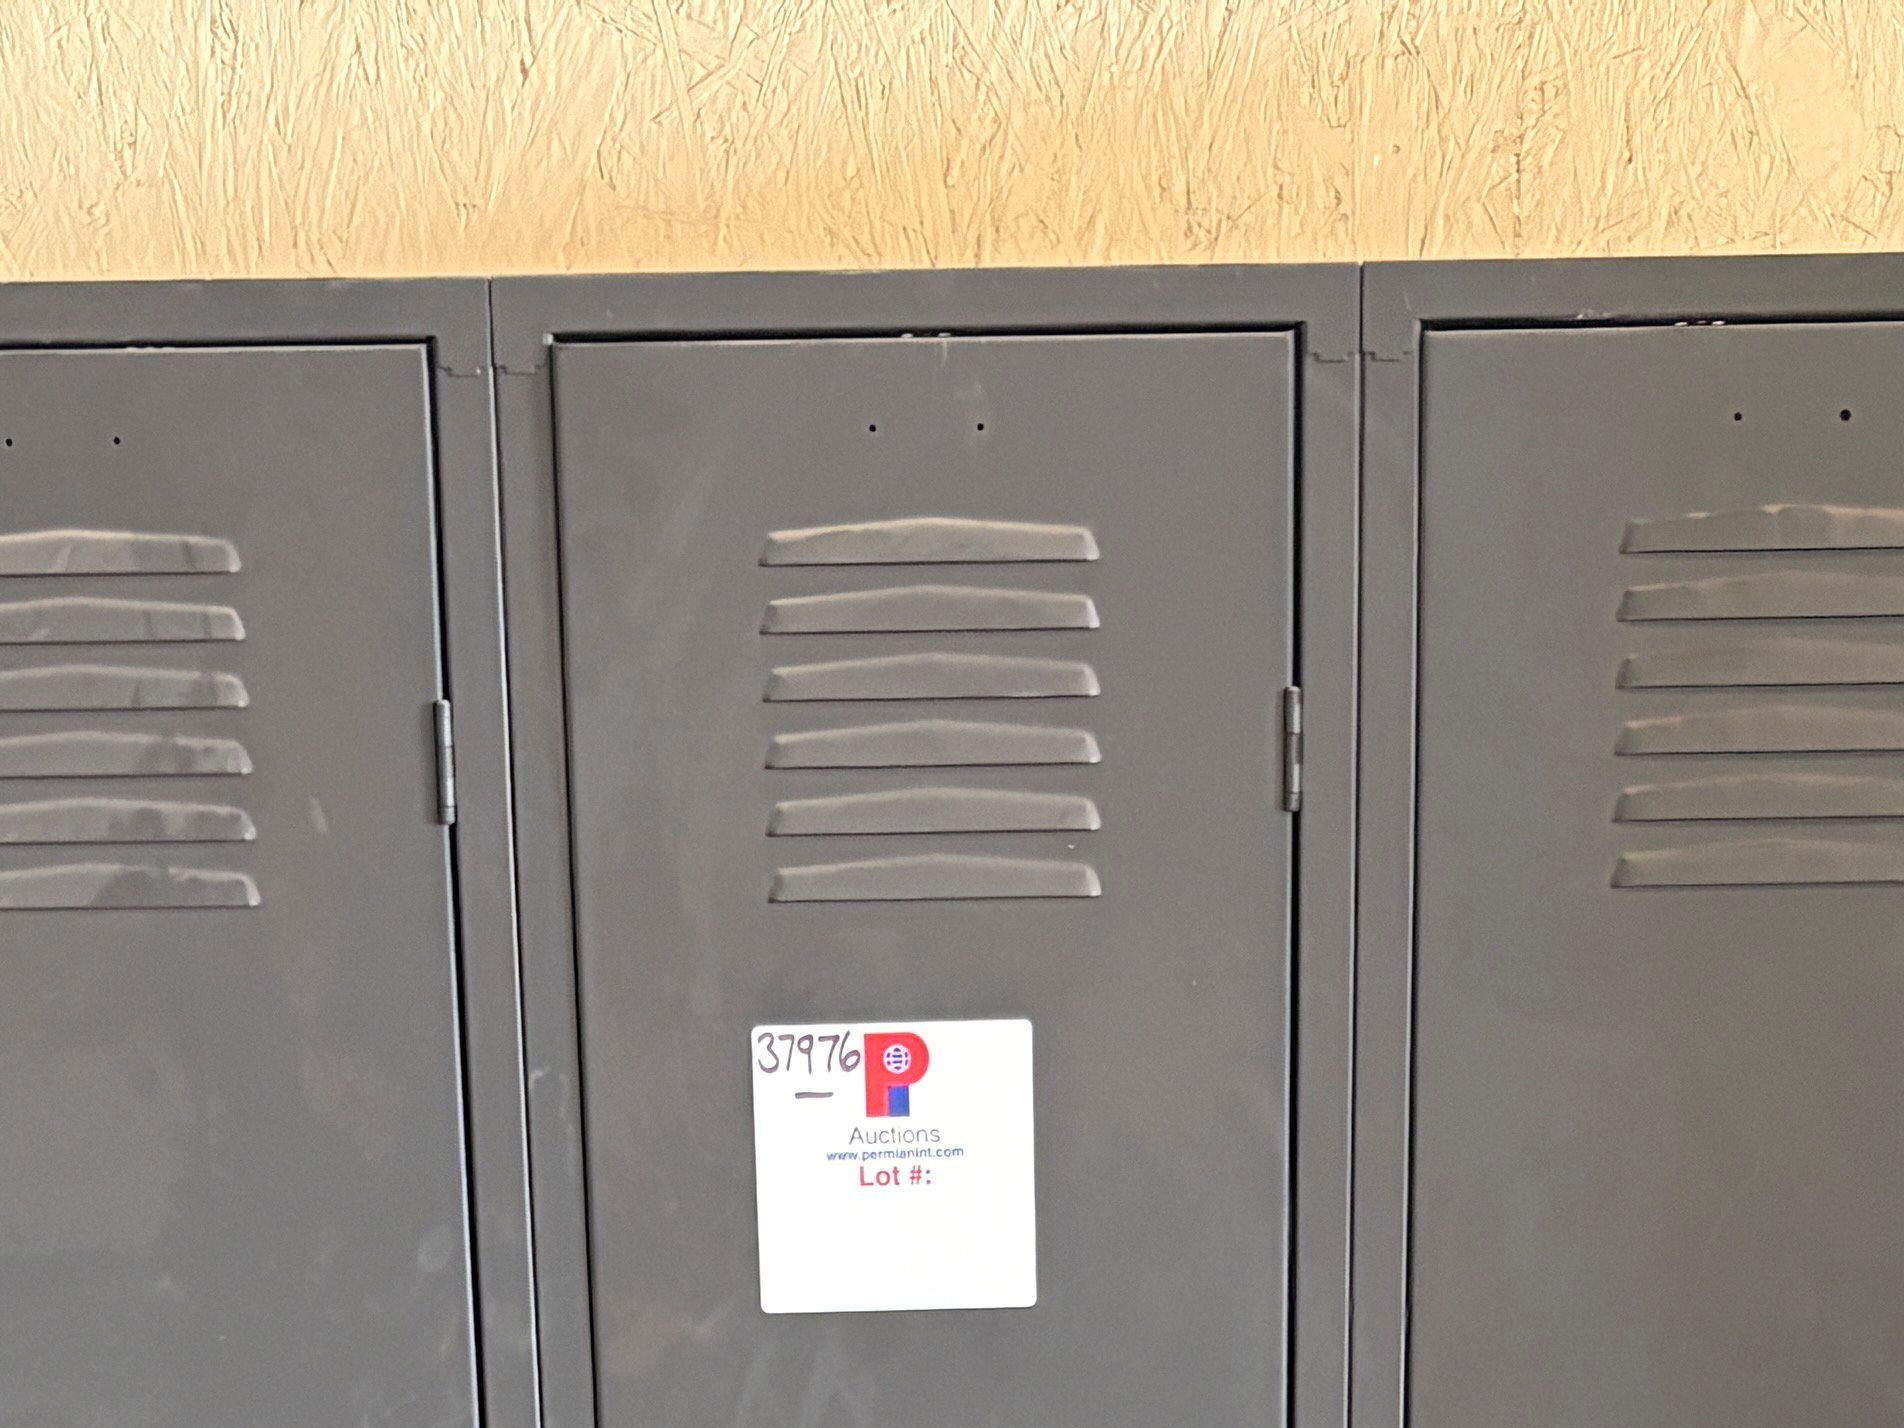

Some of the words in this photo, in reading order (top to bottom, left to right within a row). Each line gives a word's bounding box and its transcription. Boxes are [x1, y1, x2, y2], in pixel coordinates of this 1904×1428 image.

[757, 1029, 861, 1075] 37976
[848, 1126, 942, 1145] Auctions
[826, 1147, 965, 1162] www.permianint.com
[859, 1166, 901, 1187] Lot
[909, 1165, 932, 1186] #:
